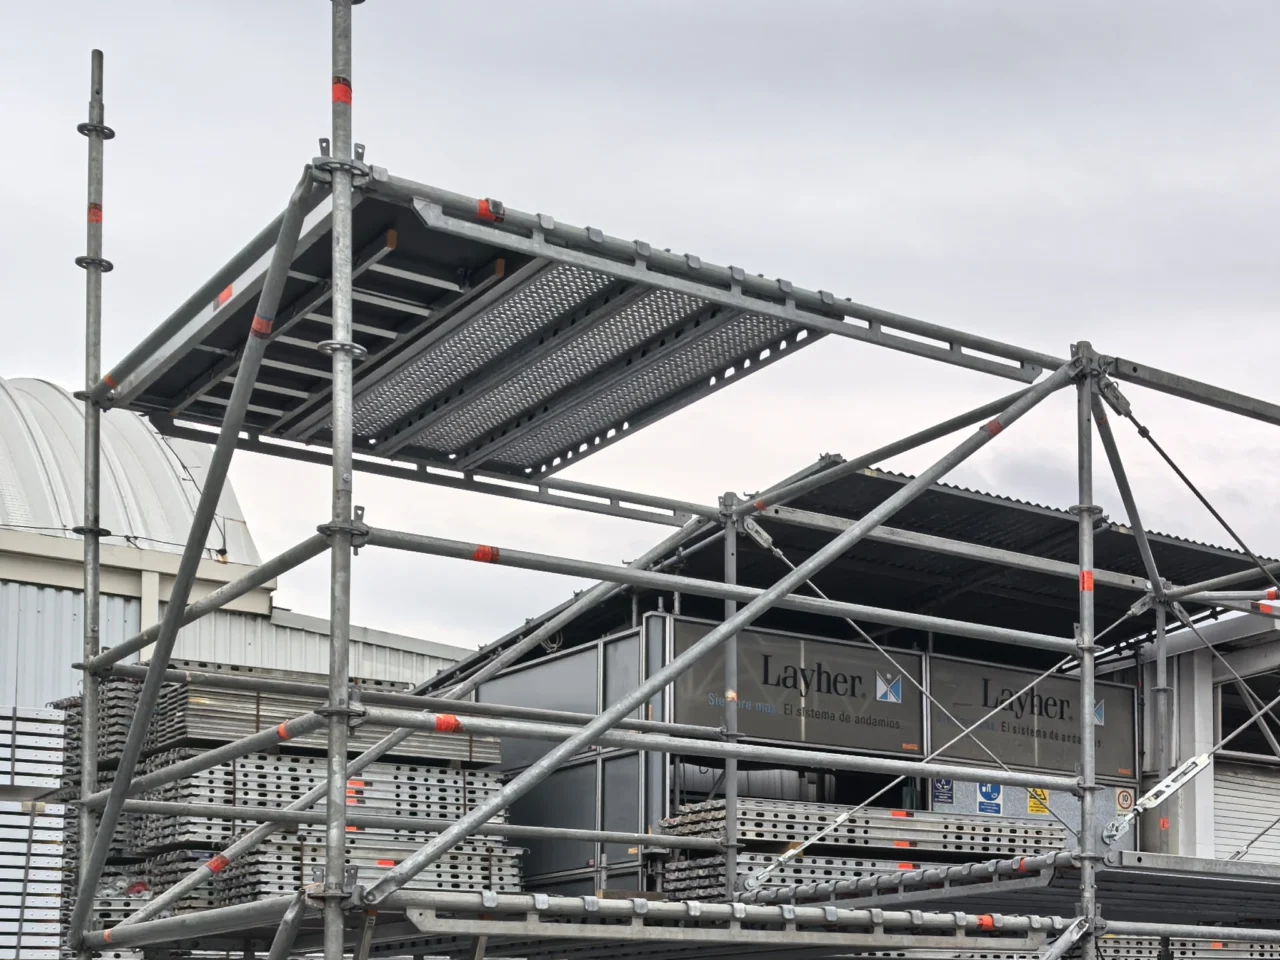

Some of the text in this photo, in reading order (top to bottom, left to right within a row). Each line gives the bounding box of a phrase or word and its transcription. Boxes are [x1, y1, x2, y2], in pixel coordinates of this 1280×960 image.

[761, 654, 864, 699] Layher
[784, 703, 793, 716] El
[796, 705, 836, 722] sistema
[839, 712, 851, 724] de
[981, 677, 1070, 721] Layher
[1001, 721, 1010, 734] El
[1013, 724, 1047, 740] sistema
[1049, 729, 1059, 742] de
